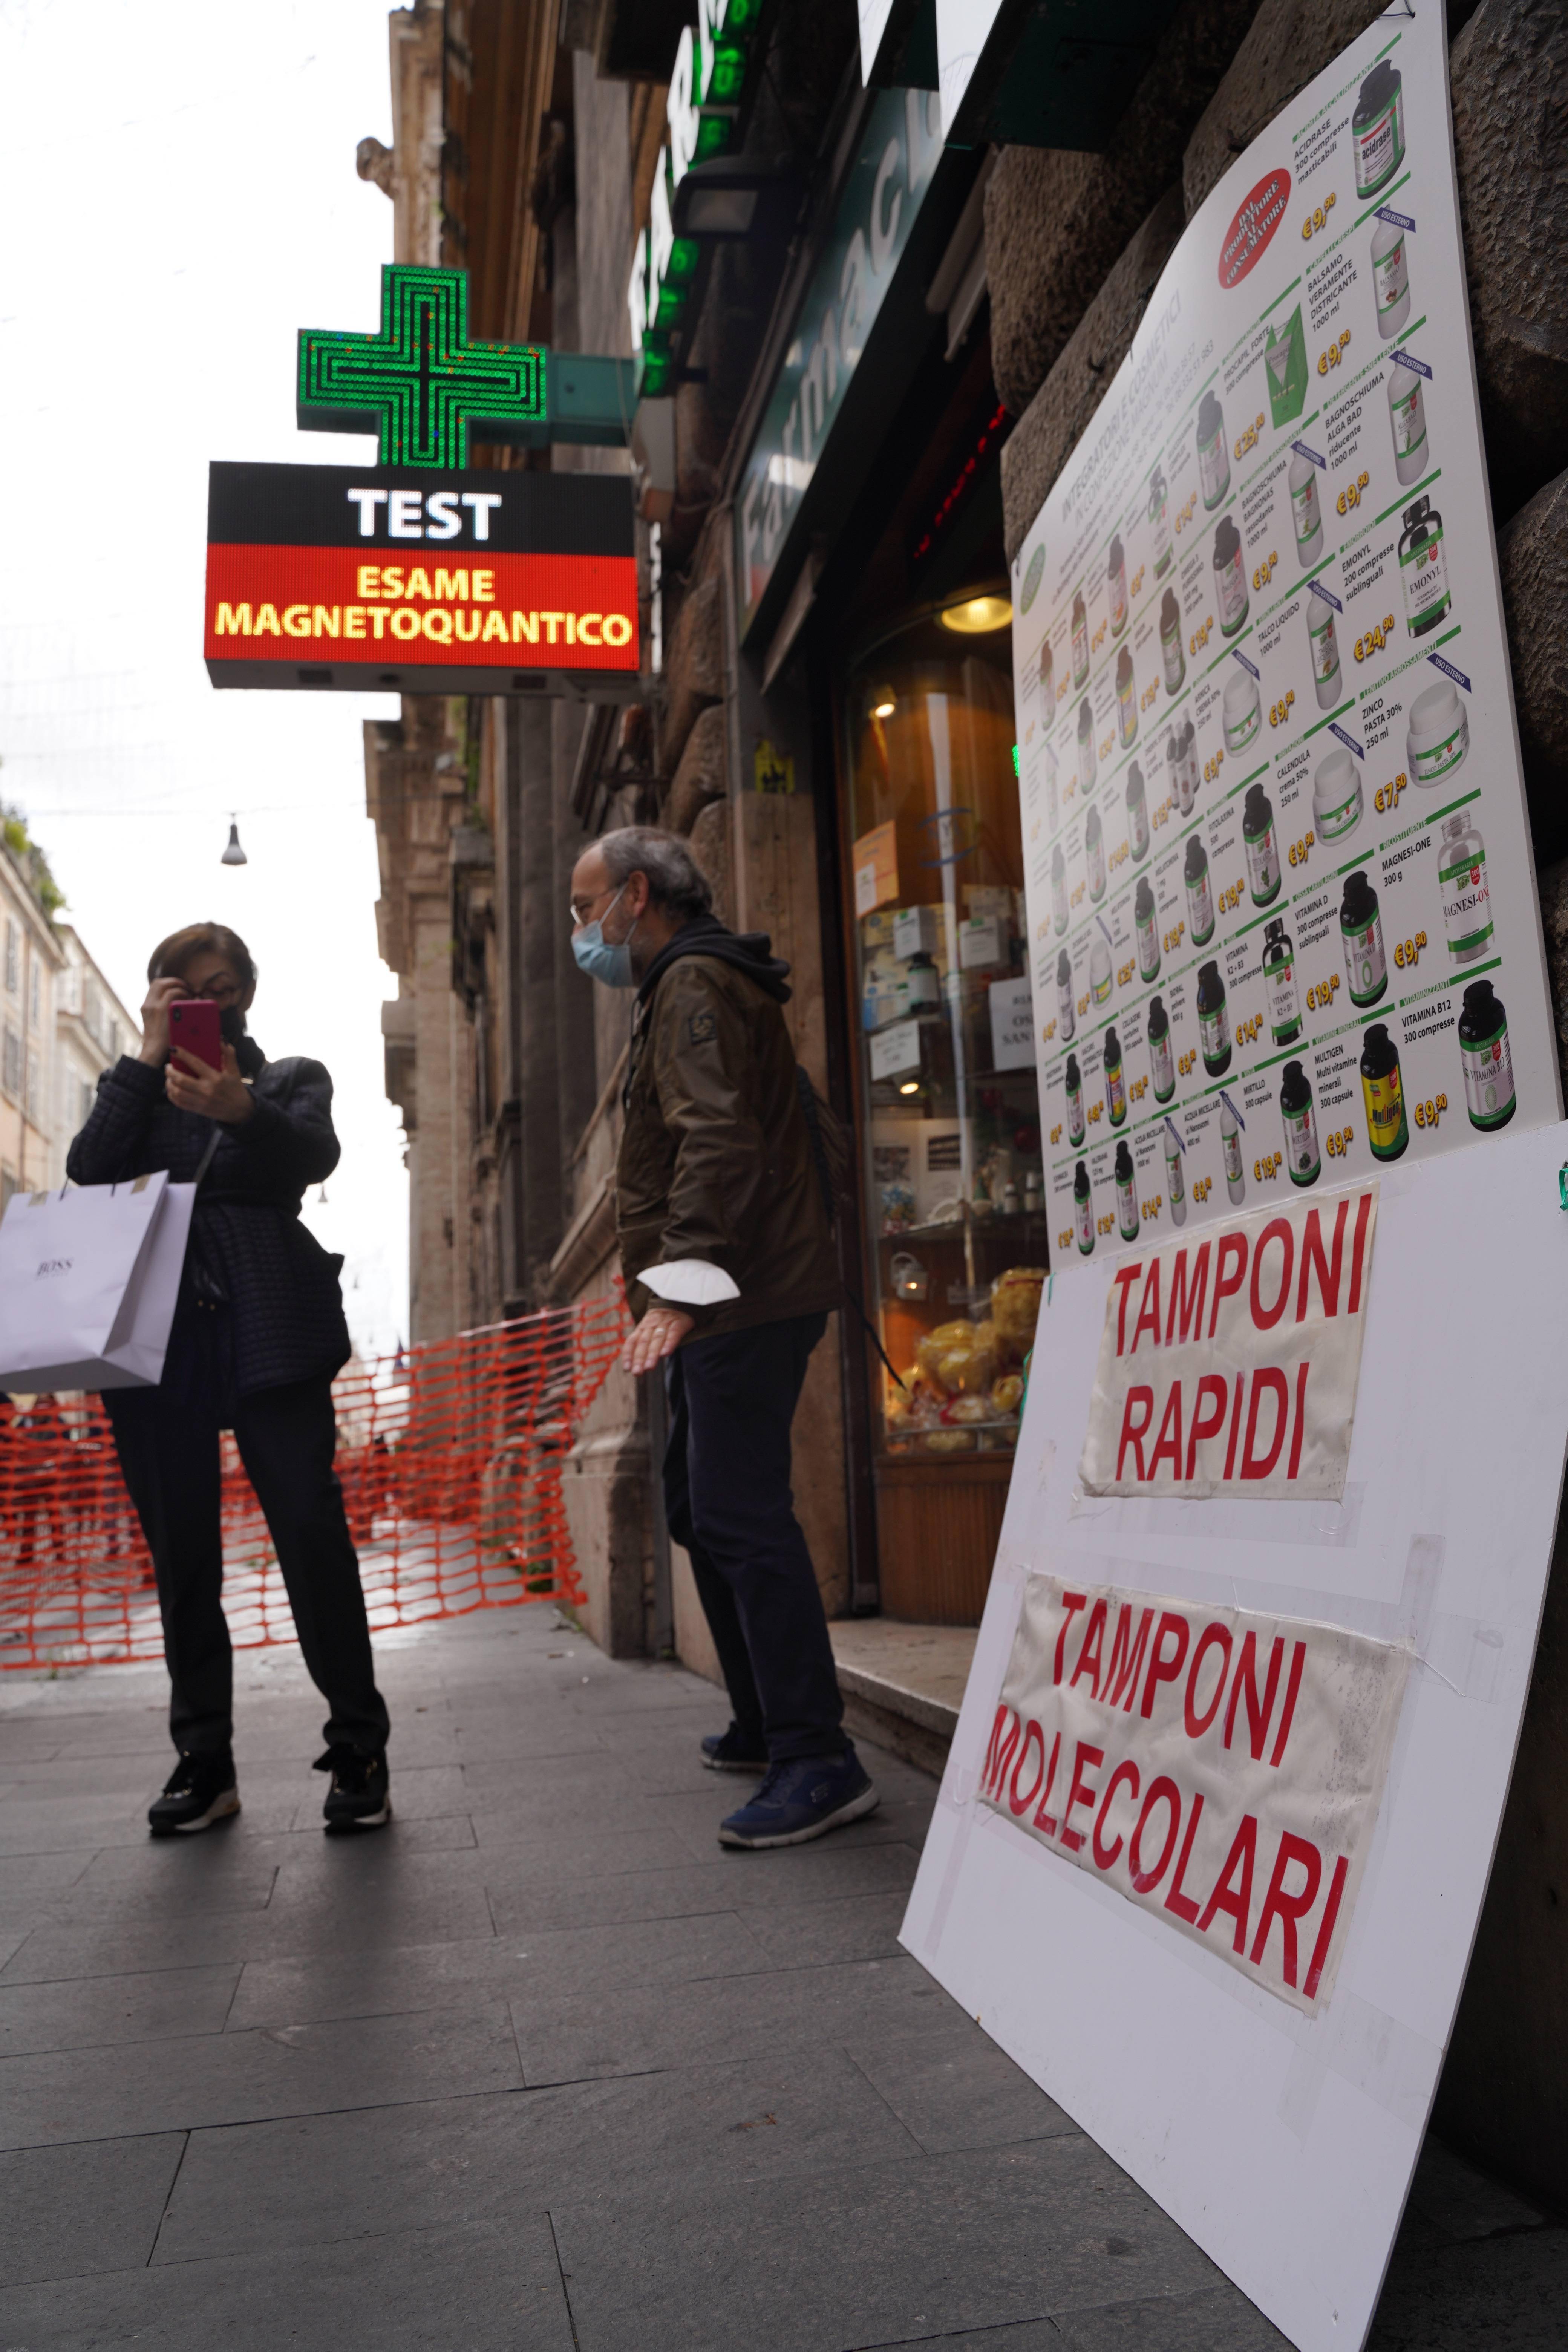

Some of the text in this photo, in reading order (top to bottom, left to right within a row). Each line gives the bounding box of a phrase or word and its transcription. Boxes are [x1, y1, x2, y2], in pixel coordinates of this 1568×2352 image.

[1294, 119, 1331, 160] ACIDRASE
[1295, 155, 1309, 174] 300
[1310, 117, 1349, 160] compresse
[1362, 125, 1391, 160] acidrase
[1298, 141, 1337, 185] masticabili
[1224, 179, 1279, 263] PRODUTTORE
[1238, 200, 1255, 228] DAL
[1302, 192, 1336, 240] €9,90
[1381, 210, 1410, 227] USO ESTERNO
[1226, 195, 1286, 285] CONSUMATORE
[1248, 222, 1260, 240] AL
[1308, 254, 1343, 293] BALSAMO
[1309, 259, 1353, 305] VERAMENTE
[1311, 270, 1358, 320] DISTRICANTE
[1312, 301, 1340, 332] 1000 ml
[1224, 349, 1250, 383] PROCAPIL
[1251, 325, 1270, 351] FORTE
[1236, 349, 1264, 384] compresse
[1317, 329, 1351, 377] €9,90
[1397, 354, 1426, 374] USO ESTERNO
[1325, 372, 1384, 429] BAGNOSCHIUMA
[1327, 407, 1362, 443] ALGA BAD
[1328, 424, 1361, 458] riducente
[1331, 442, 1358, 470] 1000 ml
[1304, 449, 1321, 464] ESTERNO
[1242, 460, 1287, 510] BAGNOSCHIUMA
[1336, 471, 1369, 516] €9,90
[347, 488, 502, 540] TEST
[1342, 544, 1371, 573] EMONYL
[1344, 543, 1394, 588] 200 compresse
[357, 566, 495, 602] ESAME
[1313, 584, 1338, 606] USO ESTERNO
[1346, 566, 1384, 602] sublinguali
[1410, 565, 1441, 595] EMONYL
[215, 603, 633, 646] MAGNETOQUANTICO
[1257, 622, 1276, 643] TALCO
[1276, 602, 1300, 628] LIQUIDO
[1260, 632, 1281, 657] 1000 ml
[1353, 614, 1395, 662] €24,90
[1363, 641, 1437, 697] LENITIVO ARROSSAMENTI
[1435, 657, 1465, 684] USO ESTERNO
[1362, 698, 1384, 720] ZINCO
[1364, 703, 1403, 735] PASTA 30%
[1334, 726, 1360, 752] USO ESTERNO
[1366, 726, 1389, 750] 250 ml
[1277, 750, 1310, 779] CALENDULA
[1424, 764, 1437, 775] ZINCO
[1437, 757, 1449, 770] PASTA
[1279, 767, 1309, 793] crema 50%
[1374, 773, 1407, 812] €7,50
[1281, 788, 1299, 808] 250 ml
[1212, 837, 1235, 859] compresse
[1383, 819, 1428, 849] RICOSTITUENTE
[1382, 836, 1431, 872] MAGNESI-ONE
[1450, 861, 1473, 876] APOTEKARIA
[1384, 871, 1403, 887] 300 g
[1471, 868, 1479, 877] 300
[1295, 895, 1328, 920] VITAMINA D
[1297, 907, 1338, 936] 300 compresse
[1299, 926, 1329, 949] sublinguali
[1394, 931, 1427, 967] €9,90
[1225, 943, 1248, 963] VITAMINA
[1238, 965, 1262, 984] compresse
[1306, 974, 1340, 1010] €19,90
[1403, 979, 1450, 1006] VITAMINIZZANTI
[1402, 999, 1452, 1027] VITAMINA B12
[1404, 1017, 1455, 1044] 300 compresse
[1315, 1044, 1343, 1065] MULTIGEN
[1492, 1041, 1500, 1052] 300
[1317, 1055, 1357, 1080] Multi vitamine
[1470, 1057, 1505, 1082] VITAMINA B12
[1243, 1079, 1265, 1095] MIRTILLO
[1318, 1077, 1341, 1094] minerali
[1321, 1089, 1353, 1109] 300 capsule
[1245, 1092, 1272, 1110] 300 capsule
[1414, 1093, 1447, 1127] €9,90
[1114, 1193, 1372, 1357] TAMPONI
[1115, 1361, 1310, 1481] RAPIDI
[1054, 1591, 1306, 1768] TAMPONI
[981, 1704, 1349, 2000] MOLECOLARI
